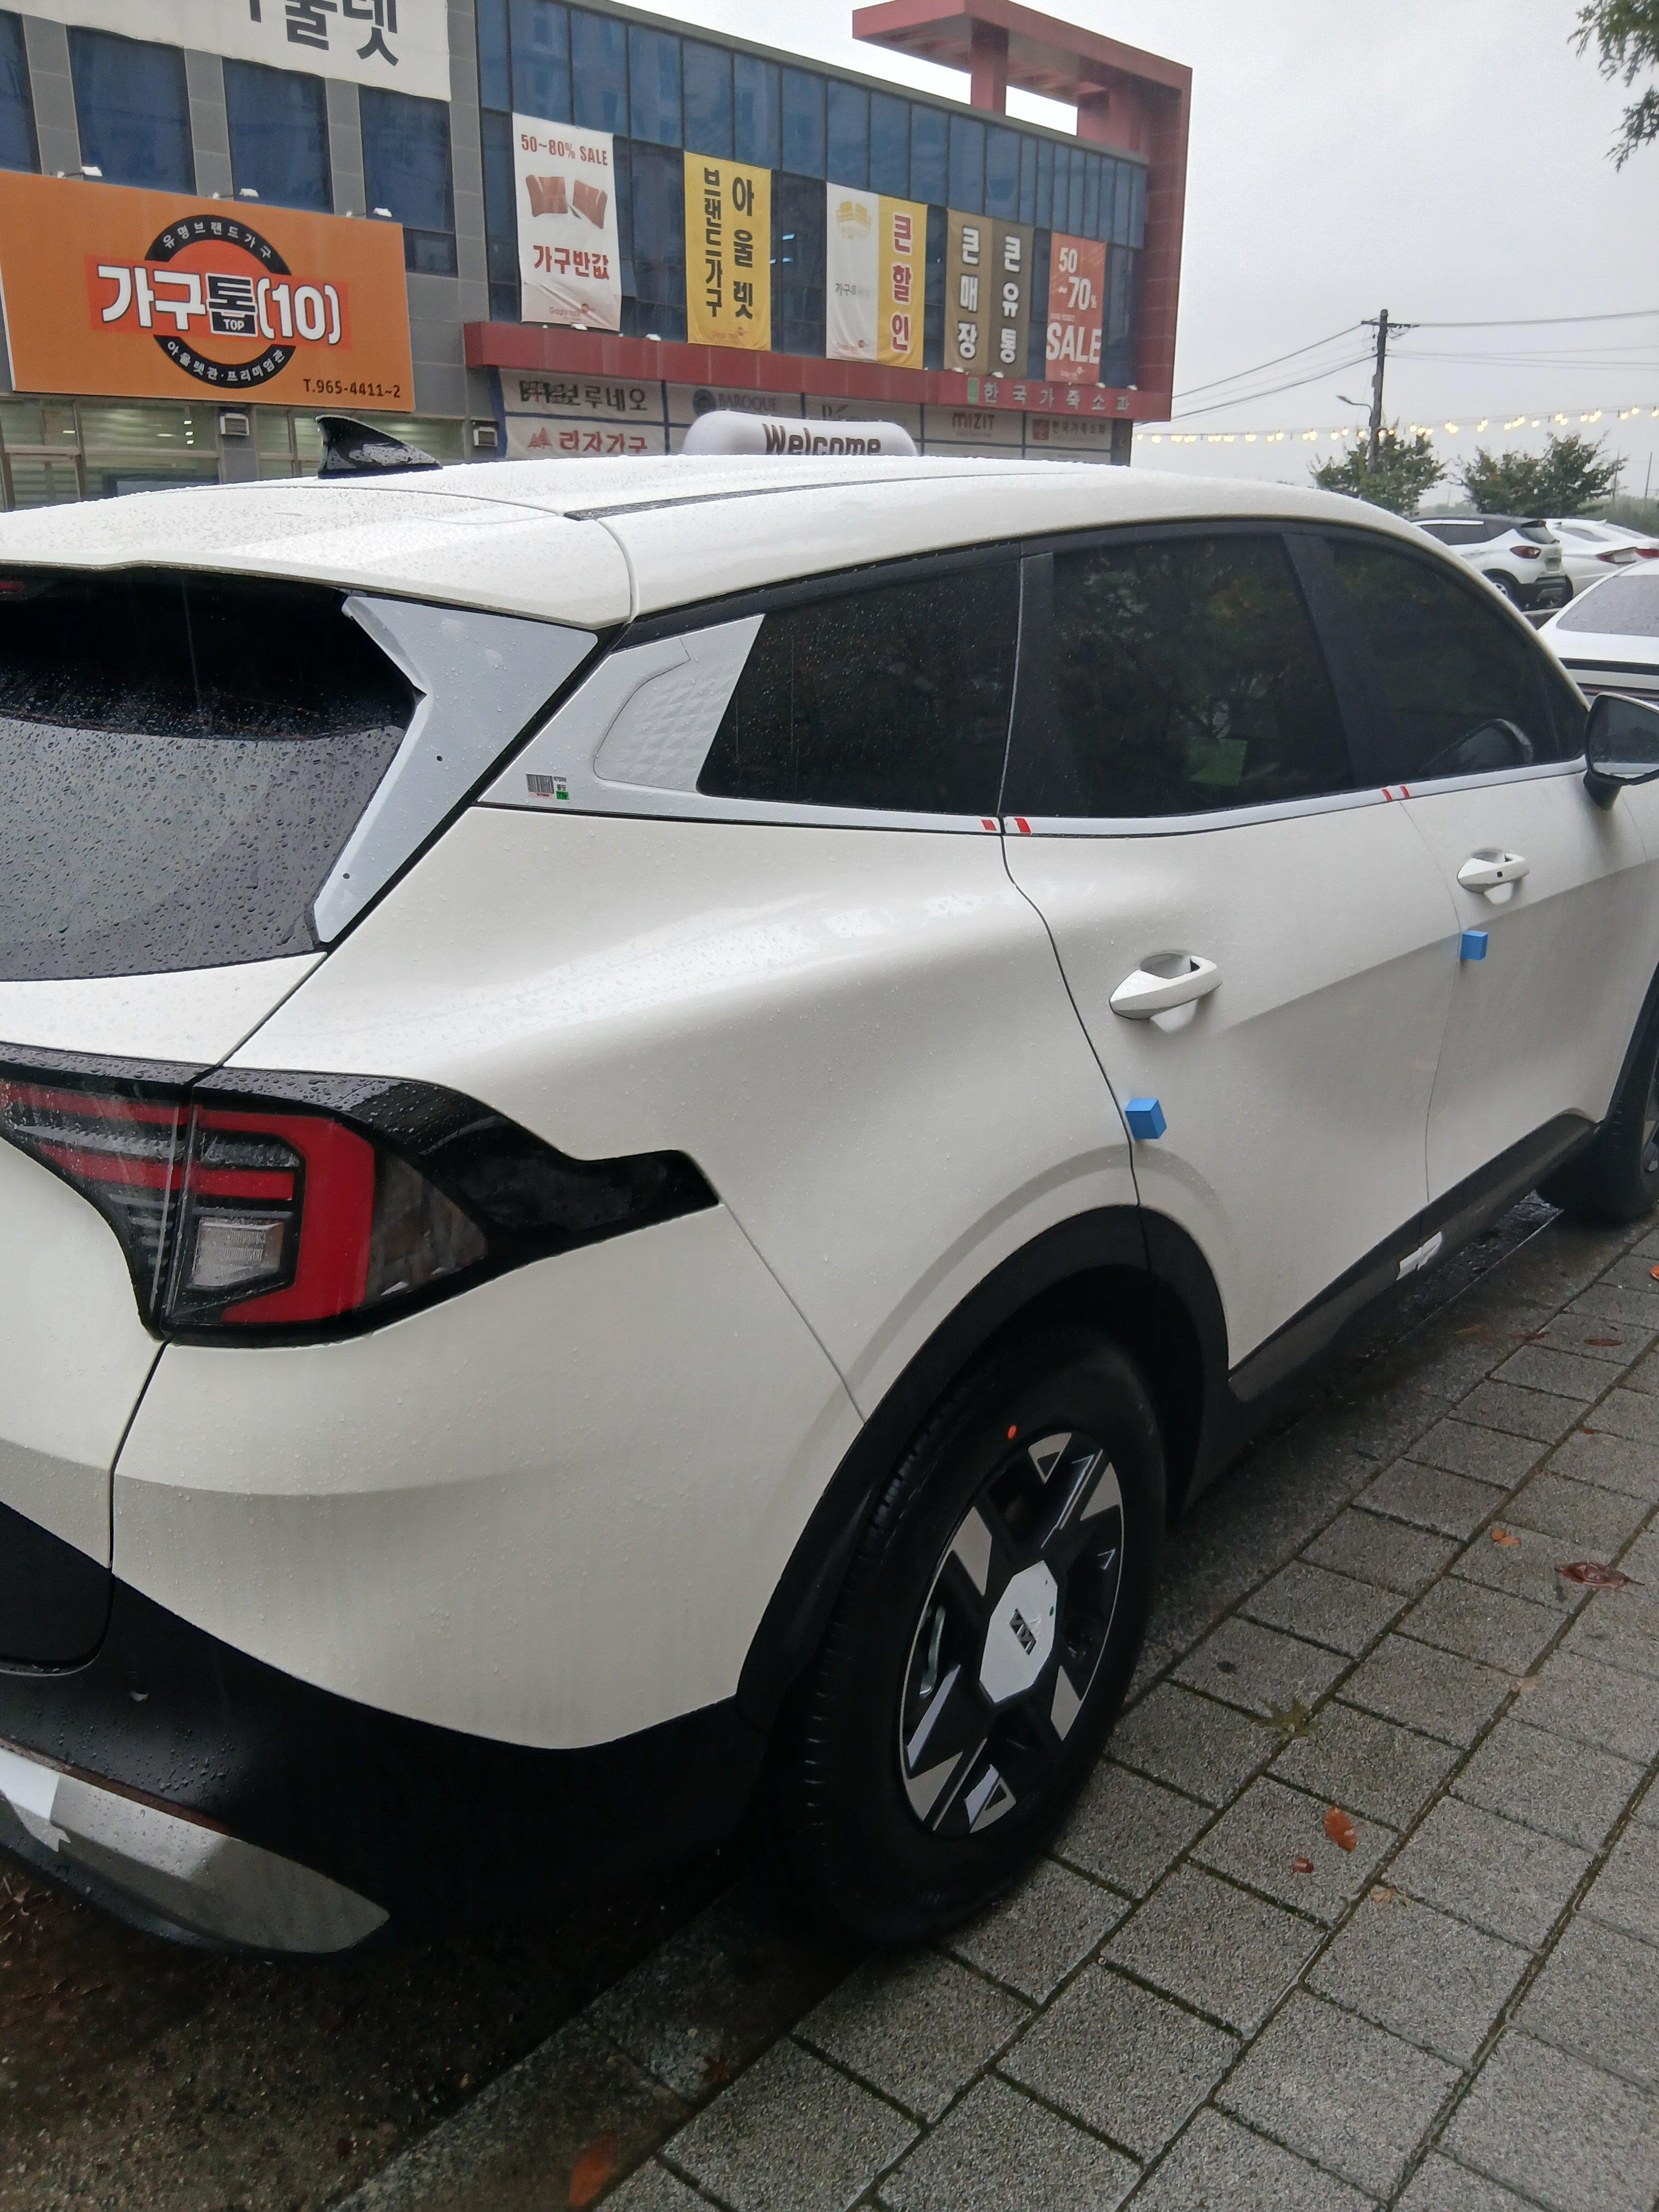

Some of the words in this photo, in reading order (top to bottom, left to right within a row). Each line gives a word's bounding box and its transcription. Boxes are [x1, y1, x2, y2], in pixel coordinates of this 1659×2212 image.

[249, 0, 398, 66] 울렛
[521, 134, 575, 159] 50~80%
[580, 145, 608, 166] SALE
[704, 168, 723, 317] 브랜드가구
[732, 176, 755, 319] 아울렛
[1058, 247, 1078, 274] 50
[533, 245, 610, 280] 가구반값
[223, 318, 245, 331] TOP
[1046, 322, 1102, 364] SALE
